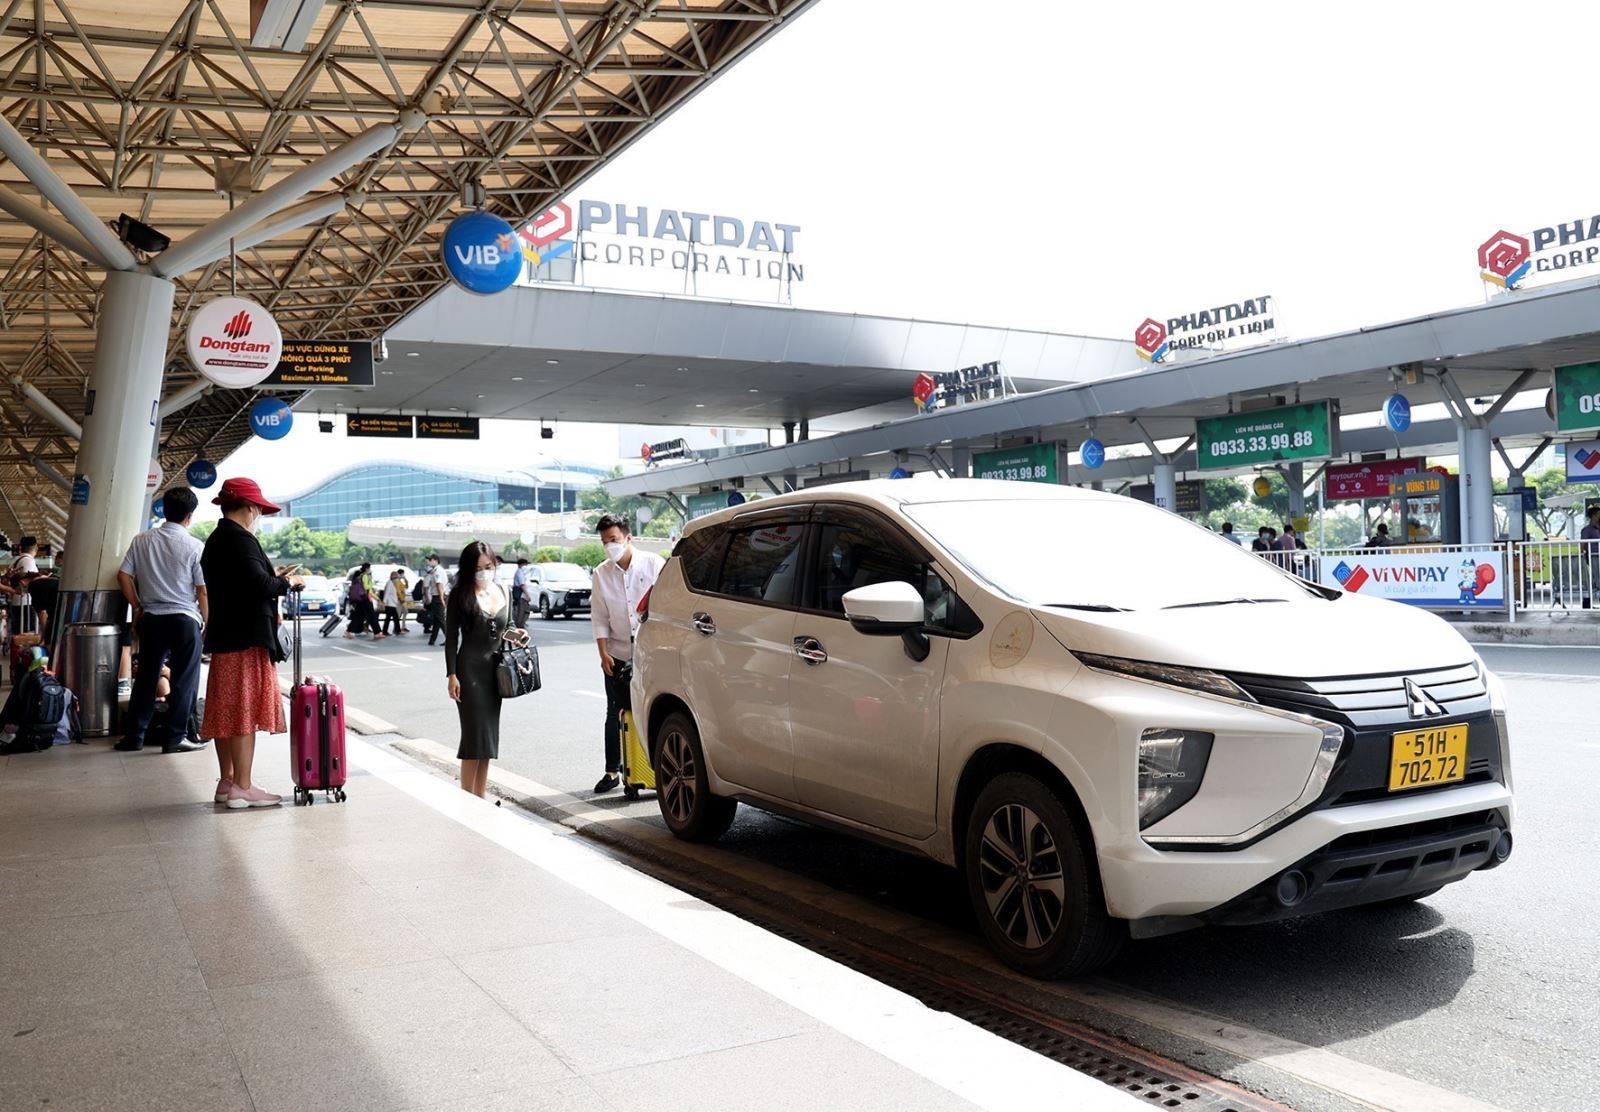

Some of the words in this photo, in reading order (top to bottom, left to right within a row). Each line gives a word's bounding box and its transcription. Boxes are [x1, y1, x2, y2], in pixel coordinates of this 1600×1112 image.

[580, 199, 801, 253] PHATDAT
[454, 243, 501, 265] VIB
[580, 241, 805, 282] CORPORATION
[1166, 295, 1272, 335] PHATDAT
[200, 336, 271, 354] Dongtam
[1168, 319, 1275, 351] CORPORATION
[279, 354, 304, 363] HÔNG
[306, 354, 323, 363] QUÁ
[331, 355, 352, 364] PHÚT
[281, 345, 294, 353] HU
[338, 345, 349, 354] XE
[294, 365, 307, 373] Car
[308, 365, 335, 374] Parking
[255, 415, 281, 427] VIB
[1211, 430, 1313, 457] 0933.33.99.88
[1372, 567, 1389, 582] Ví
[1391, 566, 1449, 582] VNPAY
[1414, 731, 1447, 757] 51H
[1400, 755, 1458, 786] 702.72
